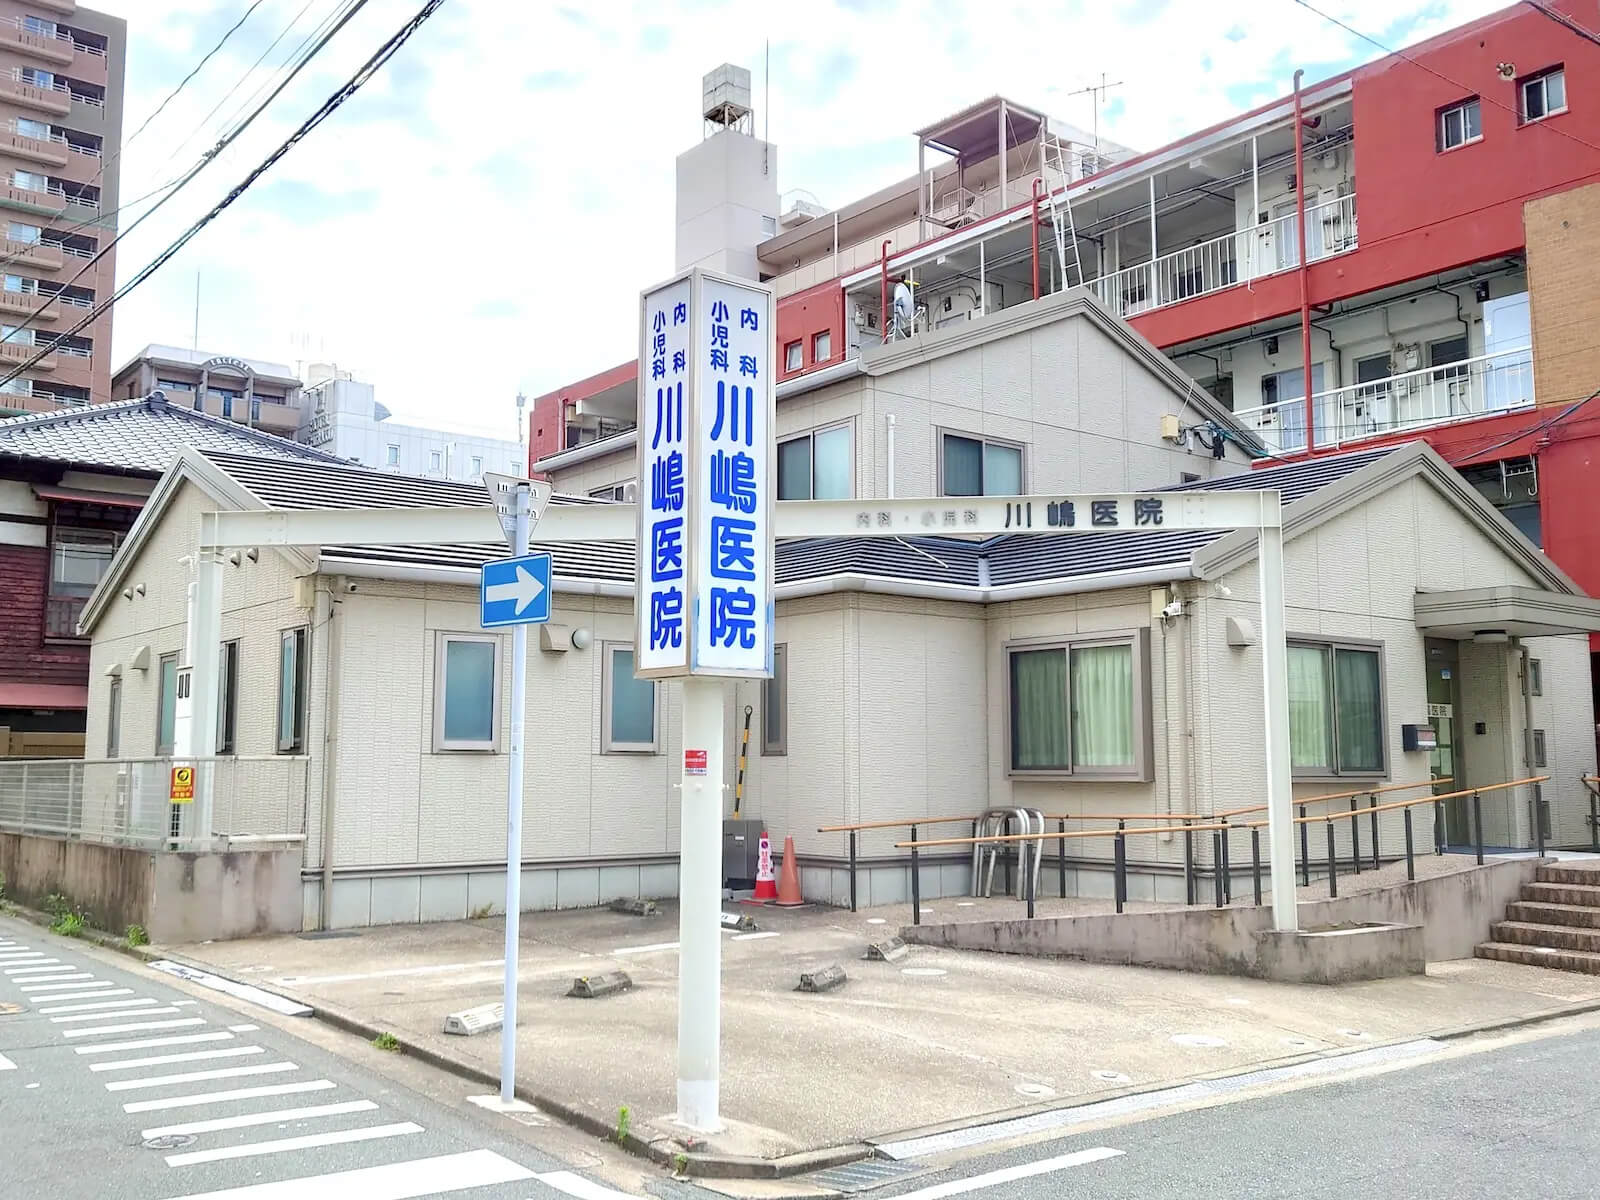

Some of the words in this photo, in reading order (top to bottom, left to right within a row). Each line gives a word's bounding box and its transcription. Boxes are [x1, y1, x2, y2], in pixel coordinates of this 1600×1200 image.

[652, 311, 667, 380] 小児科
[672, 302, 687, 373] 内科
[711, 300, 729, 373] 小児科
[739, 308, 758, 378] 内科
[651, 382, 684, 650] 川嶋医院
[710, 380, 757, 649] 川嶋医院
[1004, 498, 1163, 529] 川嶋医院
